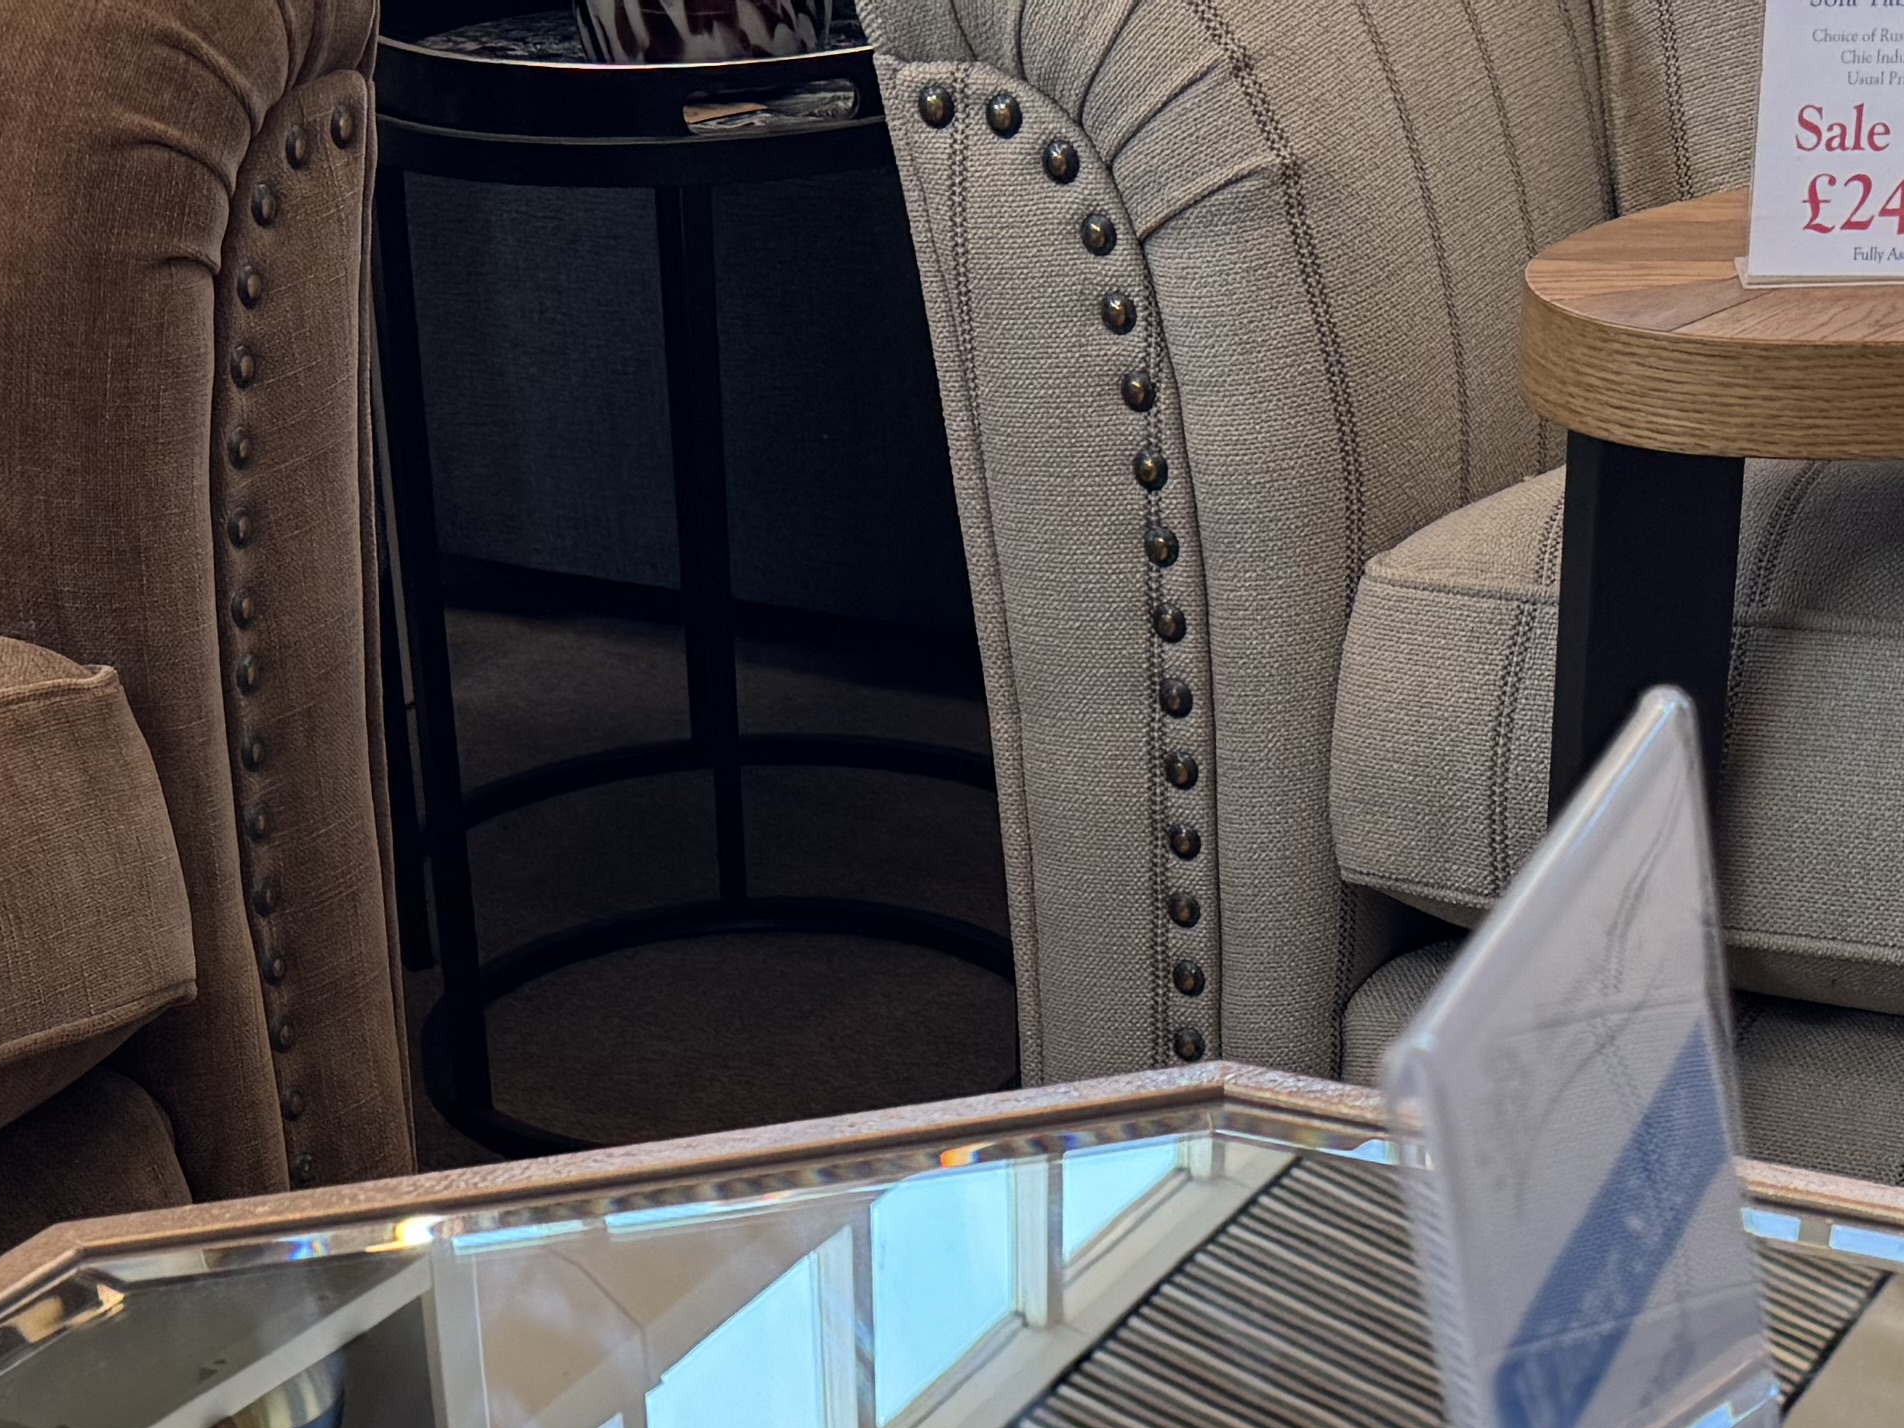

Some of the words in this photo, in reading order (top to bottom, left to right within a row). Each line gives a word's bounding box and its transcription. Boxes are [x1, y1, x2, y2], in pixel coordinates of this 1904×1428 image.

[1812, 28, 1859, 43] Choice
[1862, 27, 1876, 42] of
[1840, 49, 1872, 64] Chic
[1847, 71, 1884, 86] Usual
[1795, 102, 1891, 152] Sale
[1853, 246, 1884, 262] Fully
